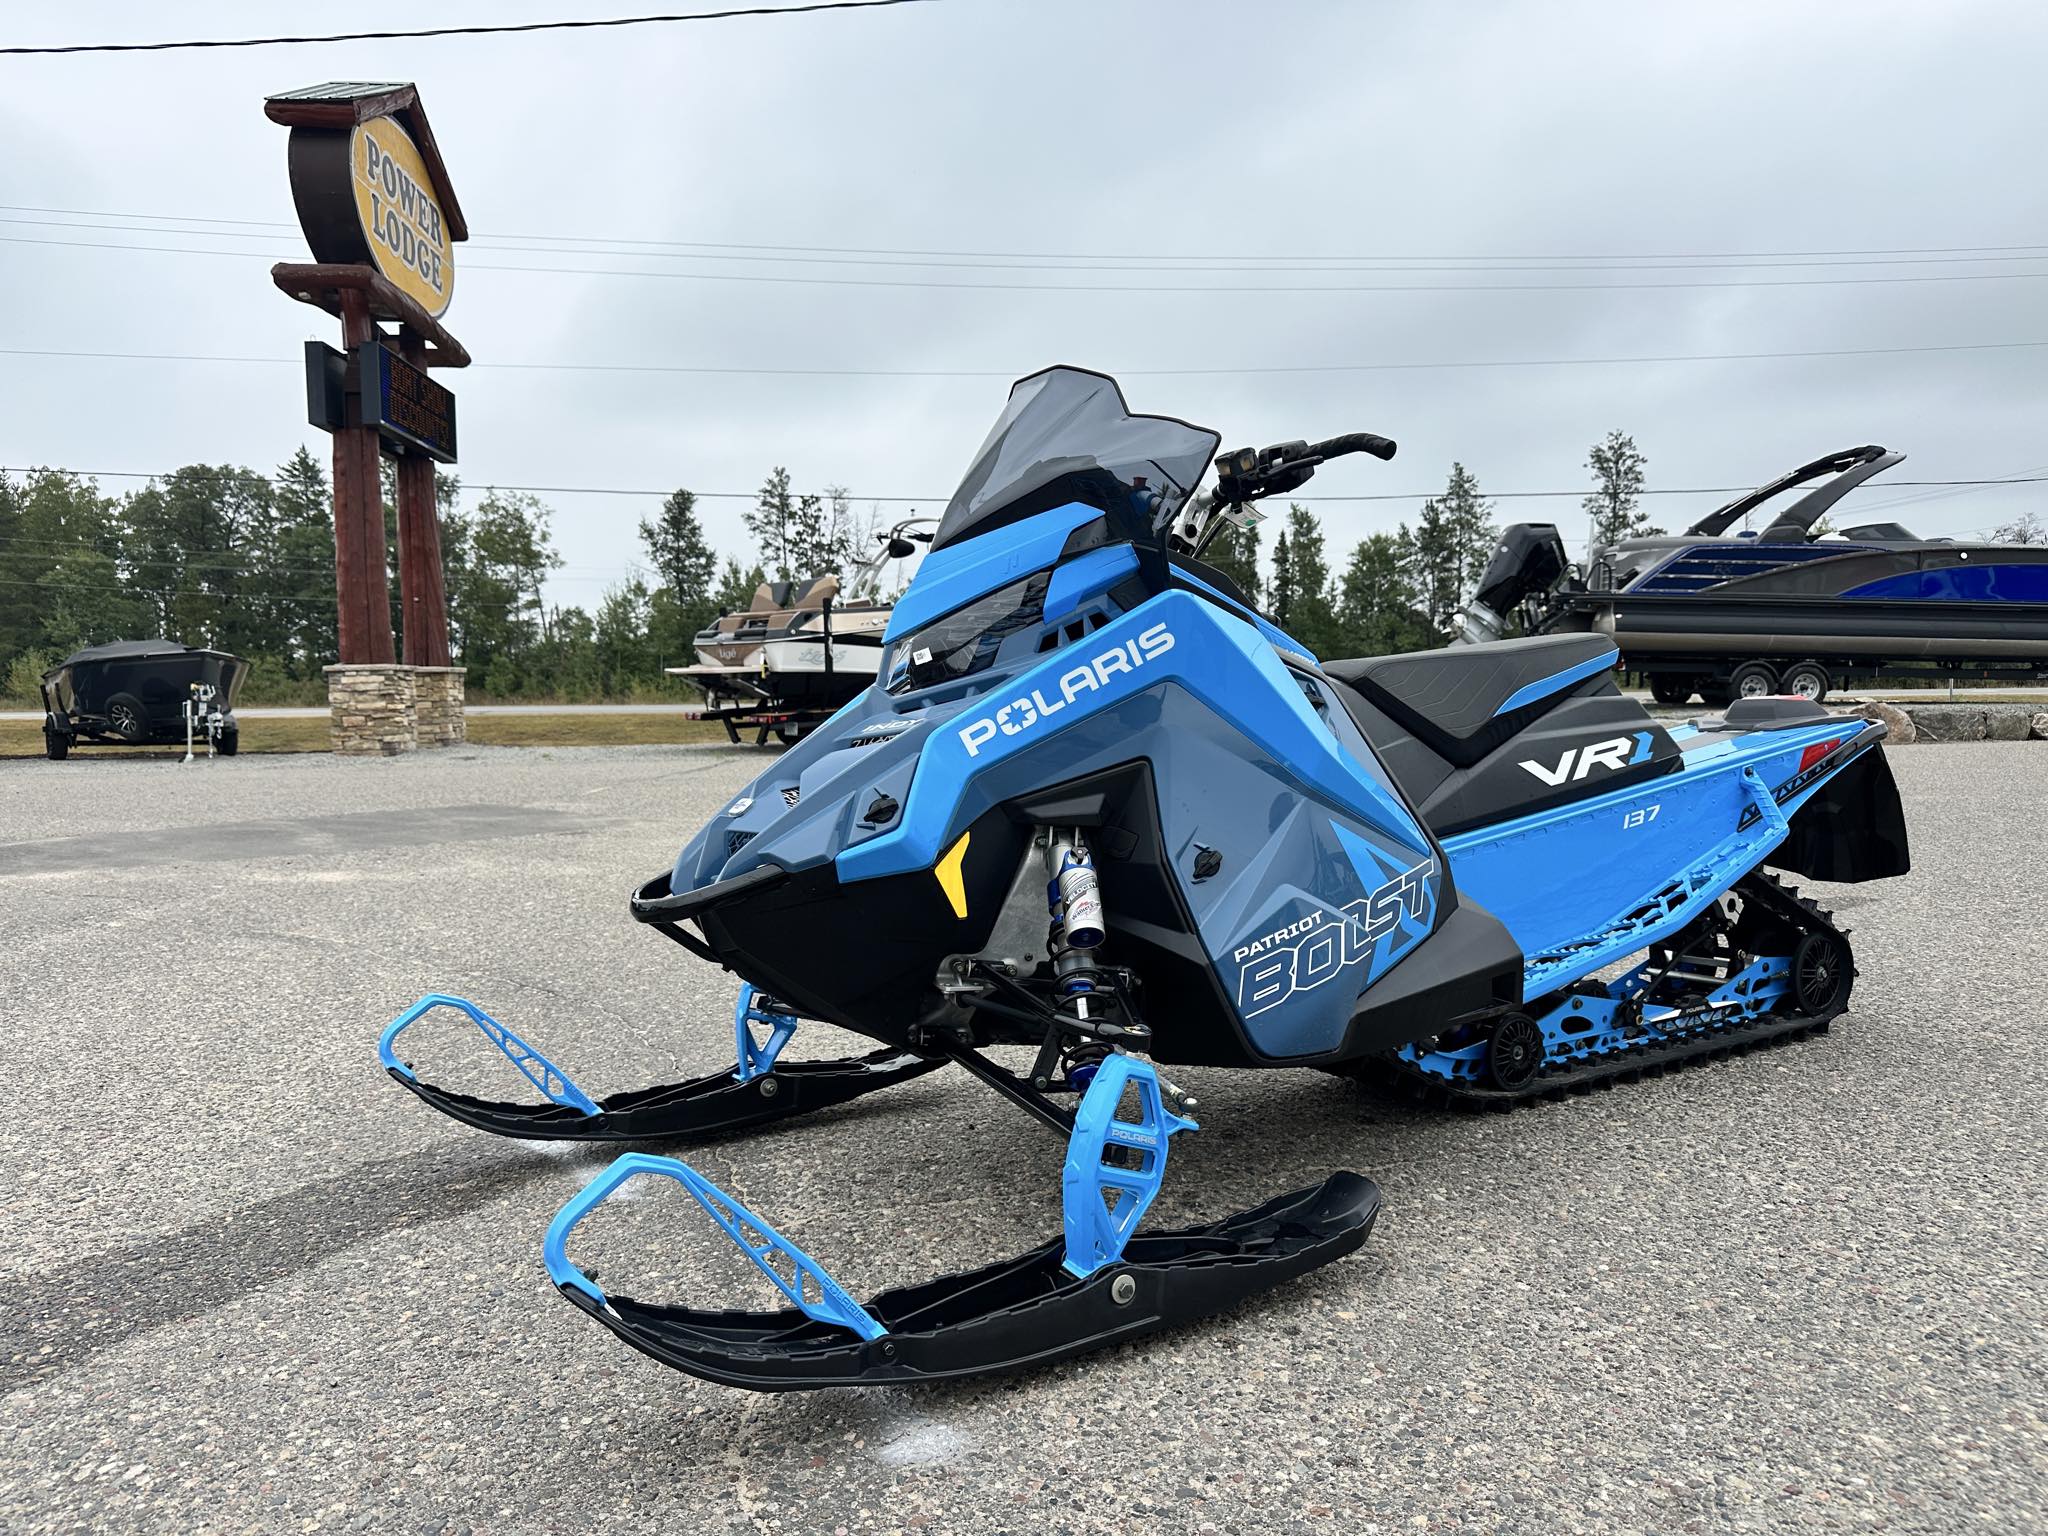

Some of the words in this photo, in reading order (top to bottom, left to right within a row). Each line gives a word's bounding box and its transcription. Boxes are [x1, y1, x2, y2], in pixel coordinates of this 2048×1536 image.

[366, 134, 444, 249] POWER
[371, 192, 443, 293] LODGE
[958, 622, 1176, 758] POLARIS
[1517, 731, 1654, 787] VR1
[1623, 804, 1661, 830] 137
[1234, 910, 1323, 963] PATRIOT
[1111, 1129, 1157, 1145] POLARIS
[821, 1277, 867, 1323] POLARIS
